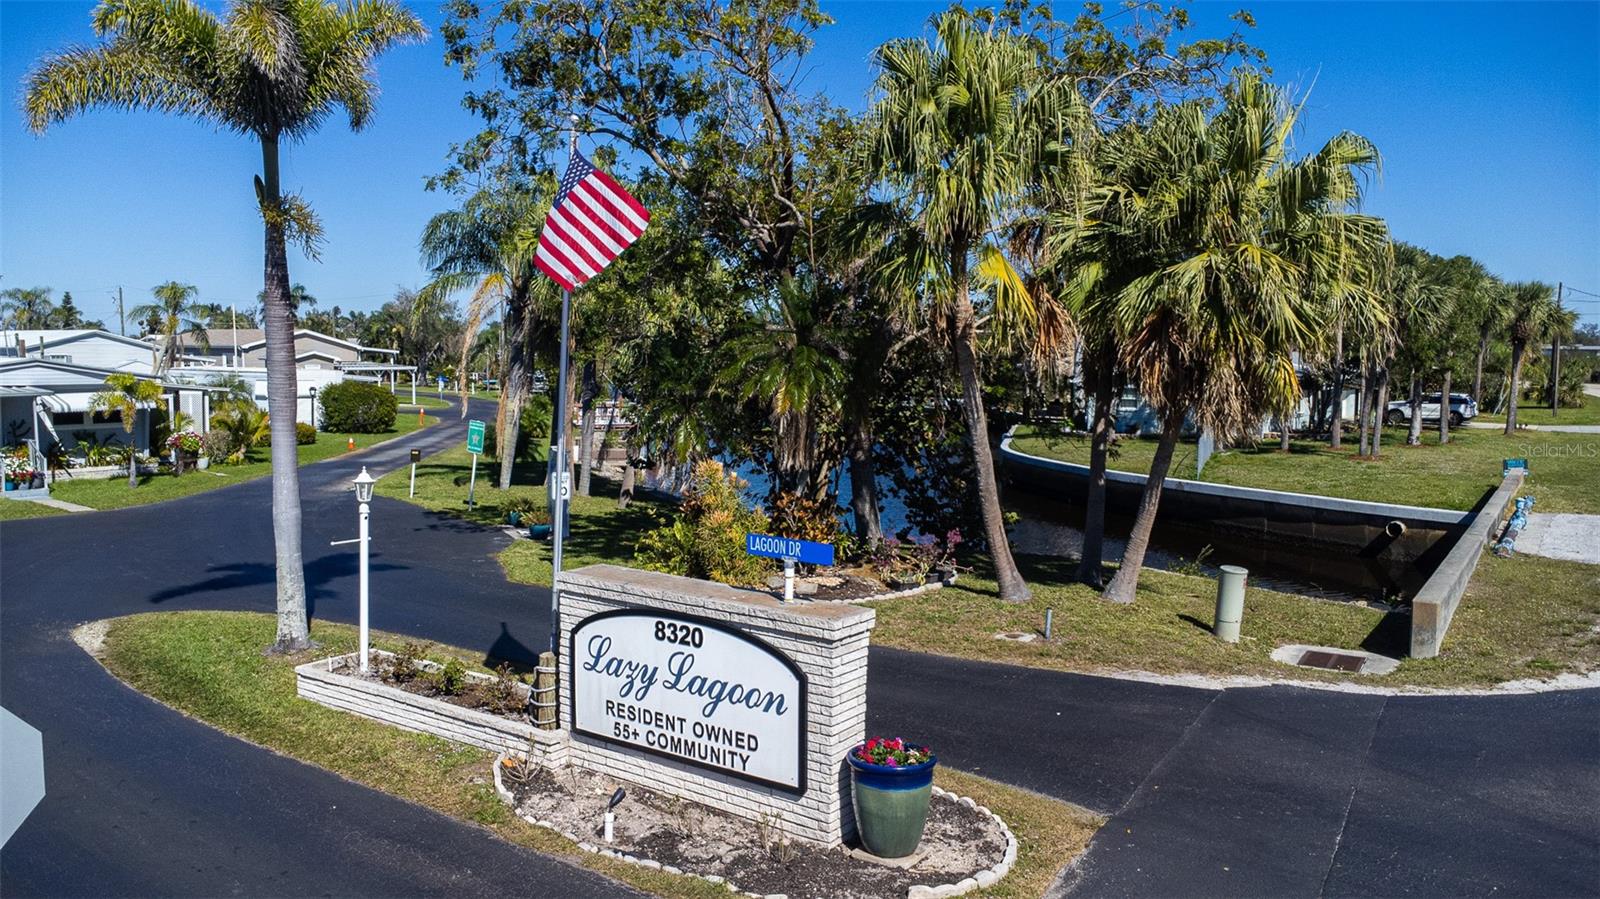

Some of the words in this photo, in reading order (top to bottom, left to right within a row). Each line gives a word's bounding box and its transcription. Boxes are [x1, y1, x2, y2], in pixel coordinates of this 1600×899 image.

[750, 535, 786, 555] LAGOON
[788, 541, 802, 557] DR
[654, 620, 704, 649] 8320
[583, 634, 658, 701] Lazy
[662, 651, 788, 718] Lagoon
[605, 700, 687, 734] RESIDENT
[692, 721, 759, 752] OWNED
[613, 721, 640, 741] 55+
[645, 730, 750, 772] COMMUNITY
